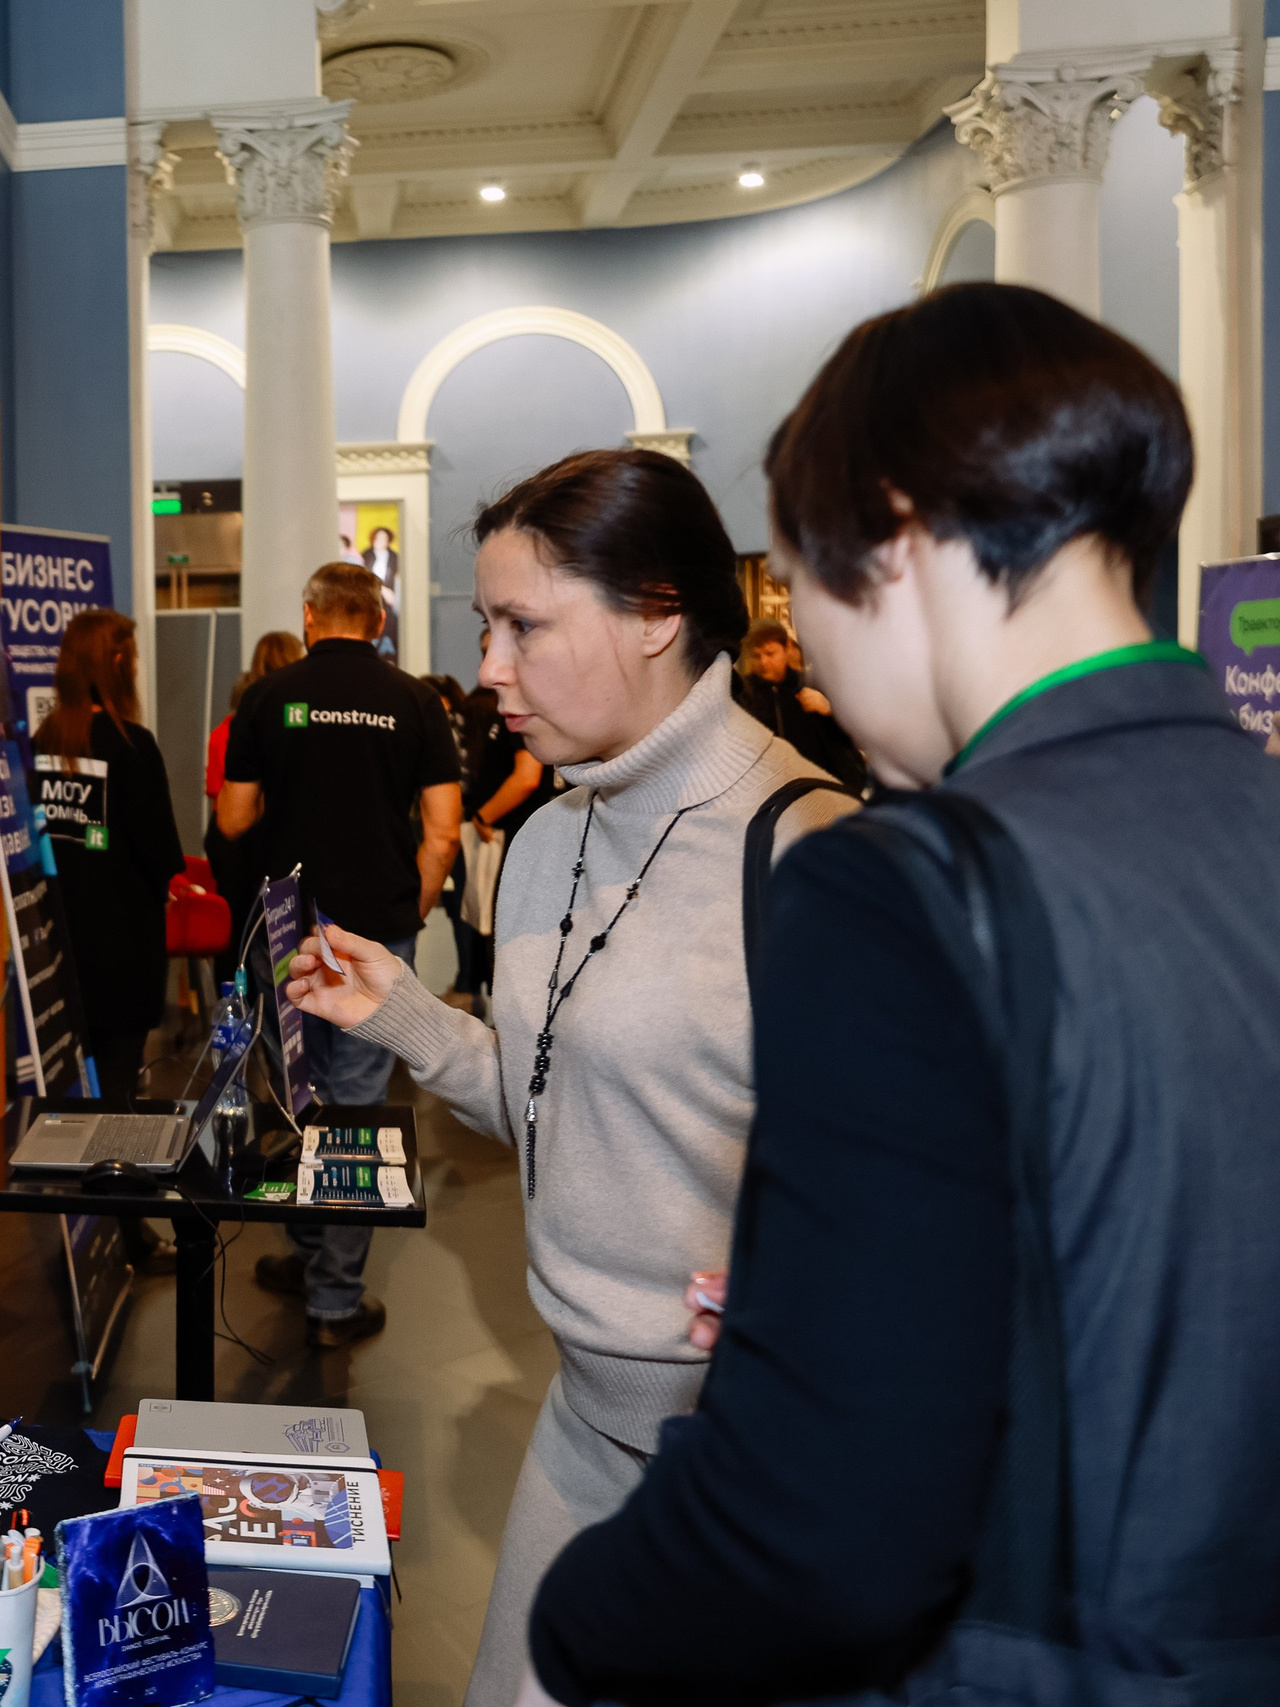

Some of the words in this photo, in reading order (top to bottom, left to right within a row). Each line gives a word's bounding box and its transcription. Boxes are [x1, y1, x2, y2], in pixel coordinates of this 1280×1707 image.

[1, 551, 95, 592] БИЗНЕС
[287, 706, 303, 724] it
[310, 708, 397, 731] construct
[1239, 702, 1275, 735] биз
[347, 1481, 366, 1543] ТИСНЕНИЕ
